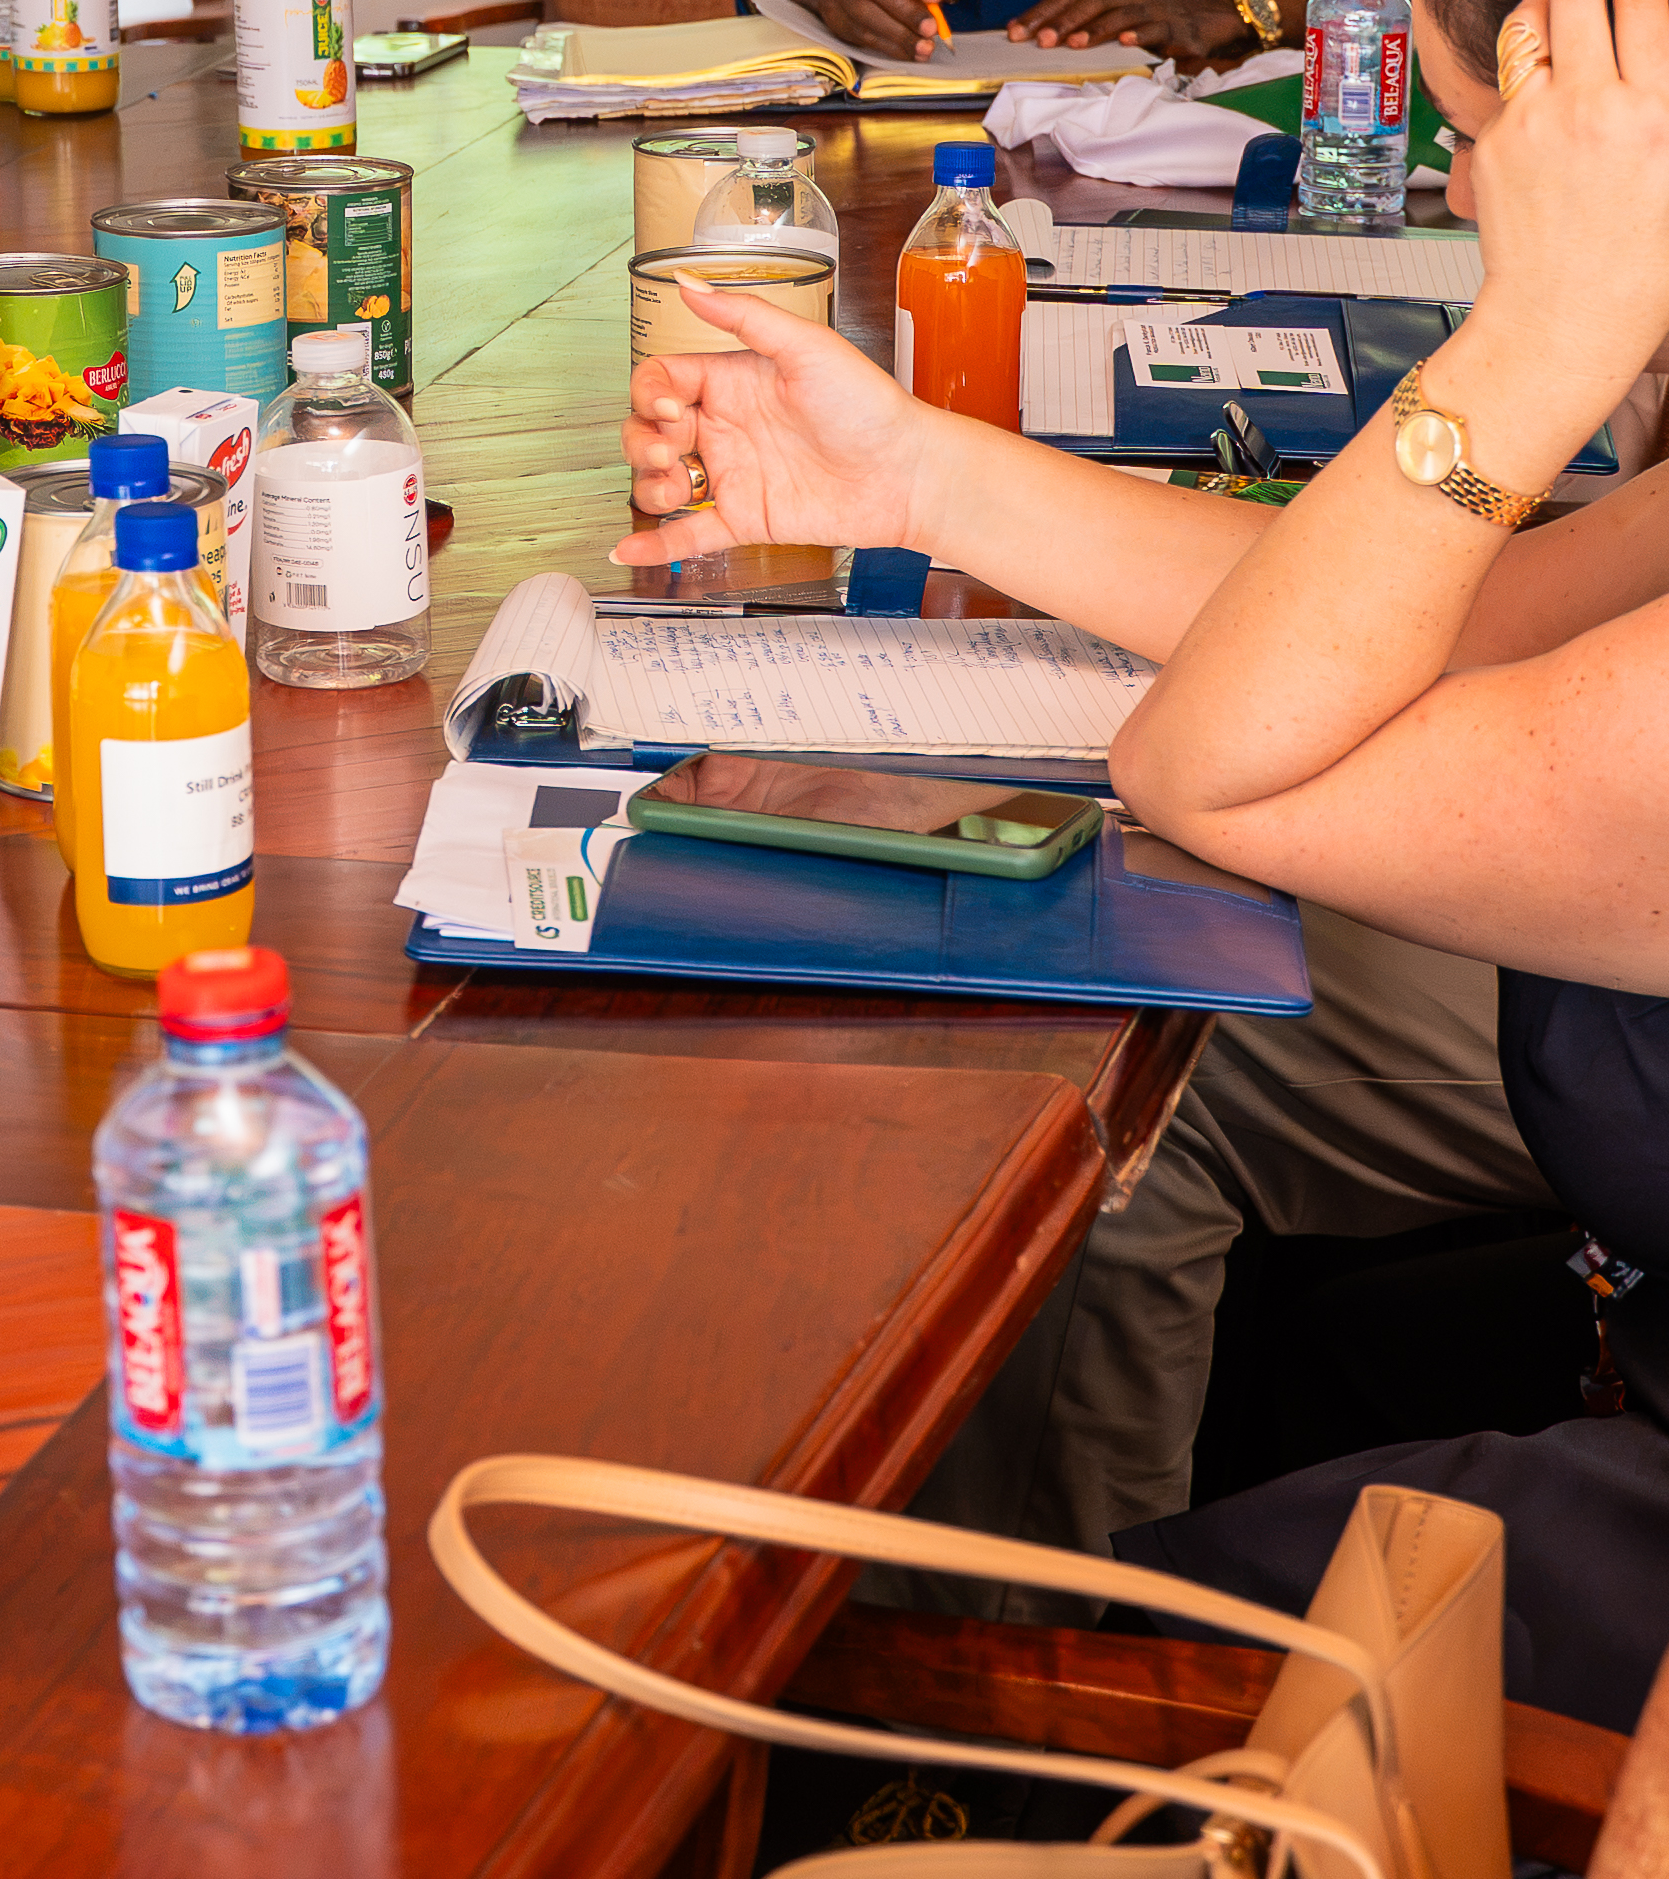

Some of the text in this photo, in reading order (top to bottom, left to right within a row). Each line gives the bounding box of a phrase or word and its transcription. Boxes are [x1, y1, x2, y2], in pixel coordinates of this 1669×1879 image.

[317, 13, 330, 56] JUICE
[1382, 39, 1401, 118] BEL-AQUA
[224, 254, 252, 262] Nutrition
[186, 770, 244, 795] Still Drink
